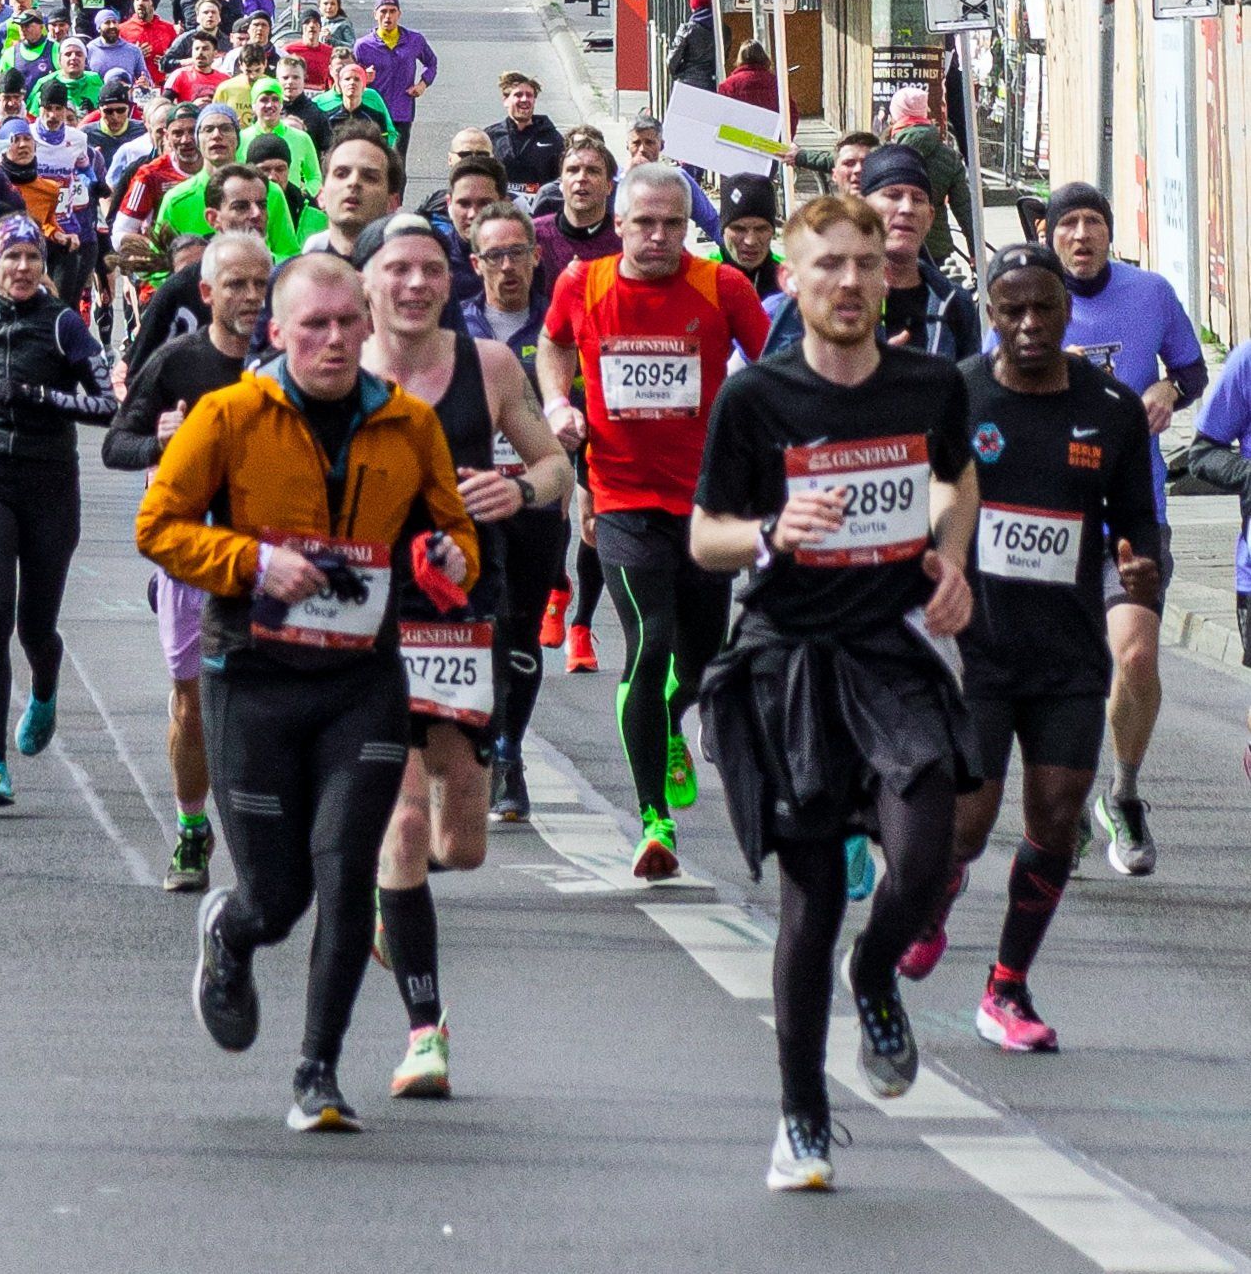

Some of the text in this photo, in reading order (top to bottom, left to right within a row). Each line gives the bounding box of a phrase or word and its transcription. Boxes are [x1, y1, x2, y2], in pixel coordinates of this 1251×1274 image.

[622, 363, 688, 387] 26954
[832, 444, 909, 467] GENERALI
[824, 477, 914, 517] 2899
[991, 519, 1070, 556] 16560
[1005, 554, 1041, 569] Marcel
